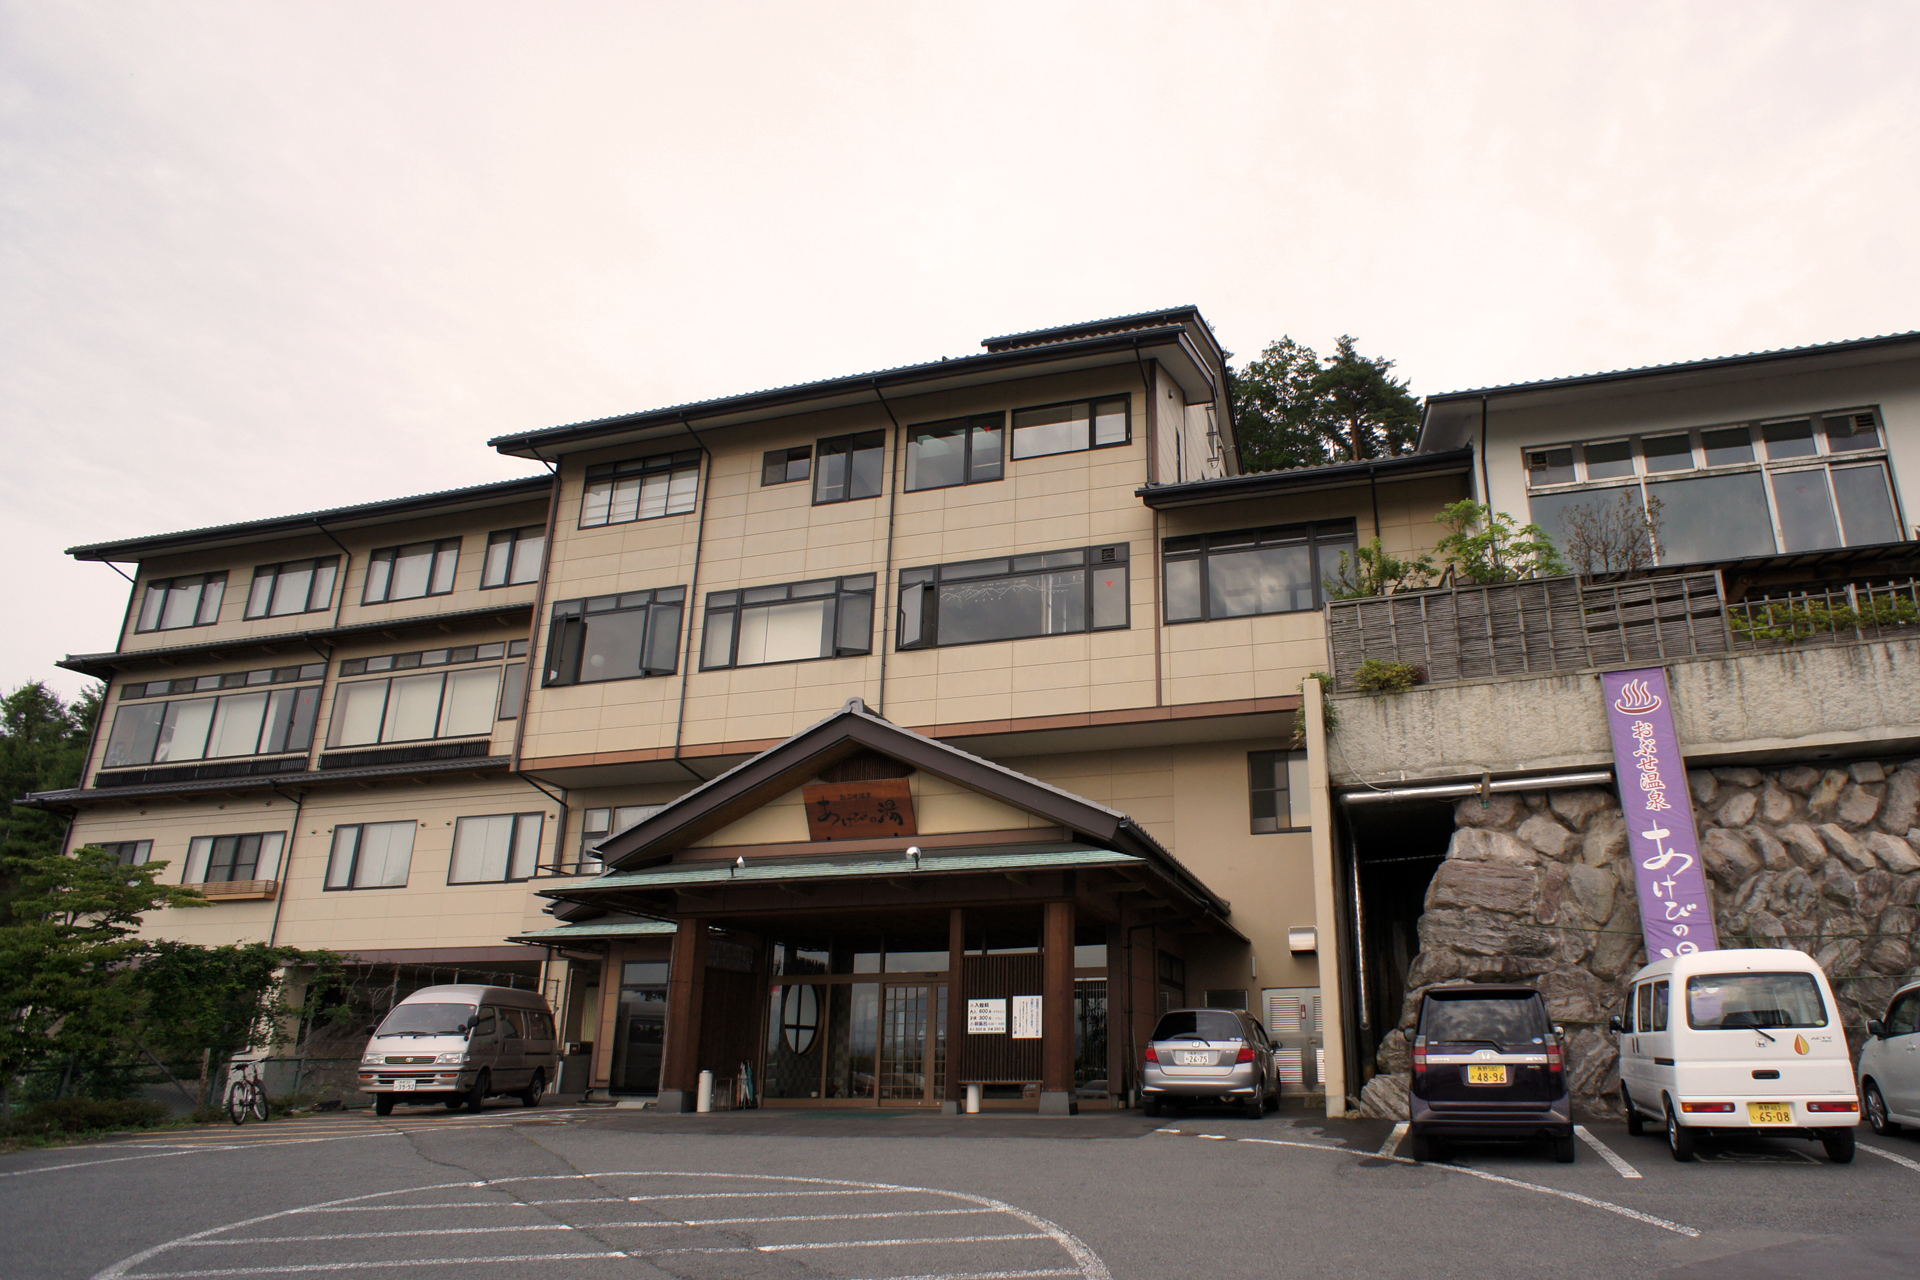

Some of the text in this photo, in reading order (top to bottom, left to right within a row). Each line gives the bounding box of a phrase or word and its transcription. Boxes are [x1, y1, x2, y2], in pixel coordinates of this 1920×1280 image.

[1632, 720, 1671, 811] おぶせ温泉
[817, 795, 904, 827] あけびの湯
[1477, 1073, 1505, 1082] 48-96
[1760, 1111, 1790, 1122] 65-08
